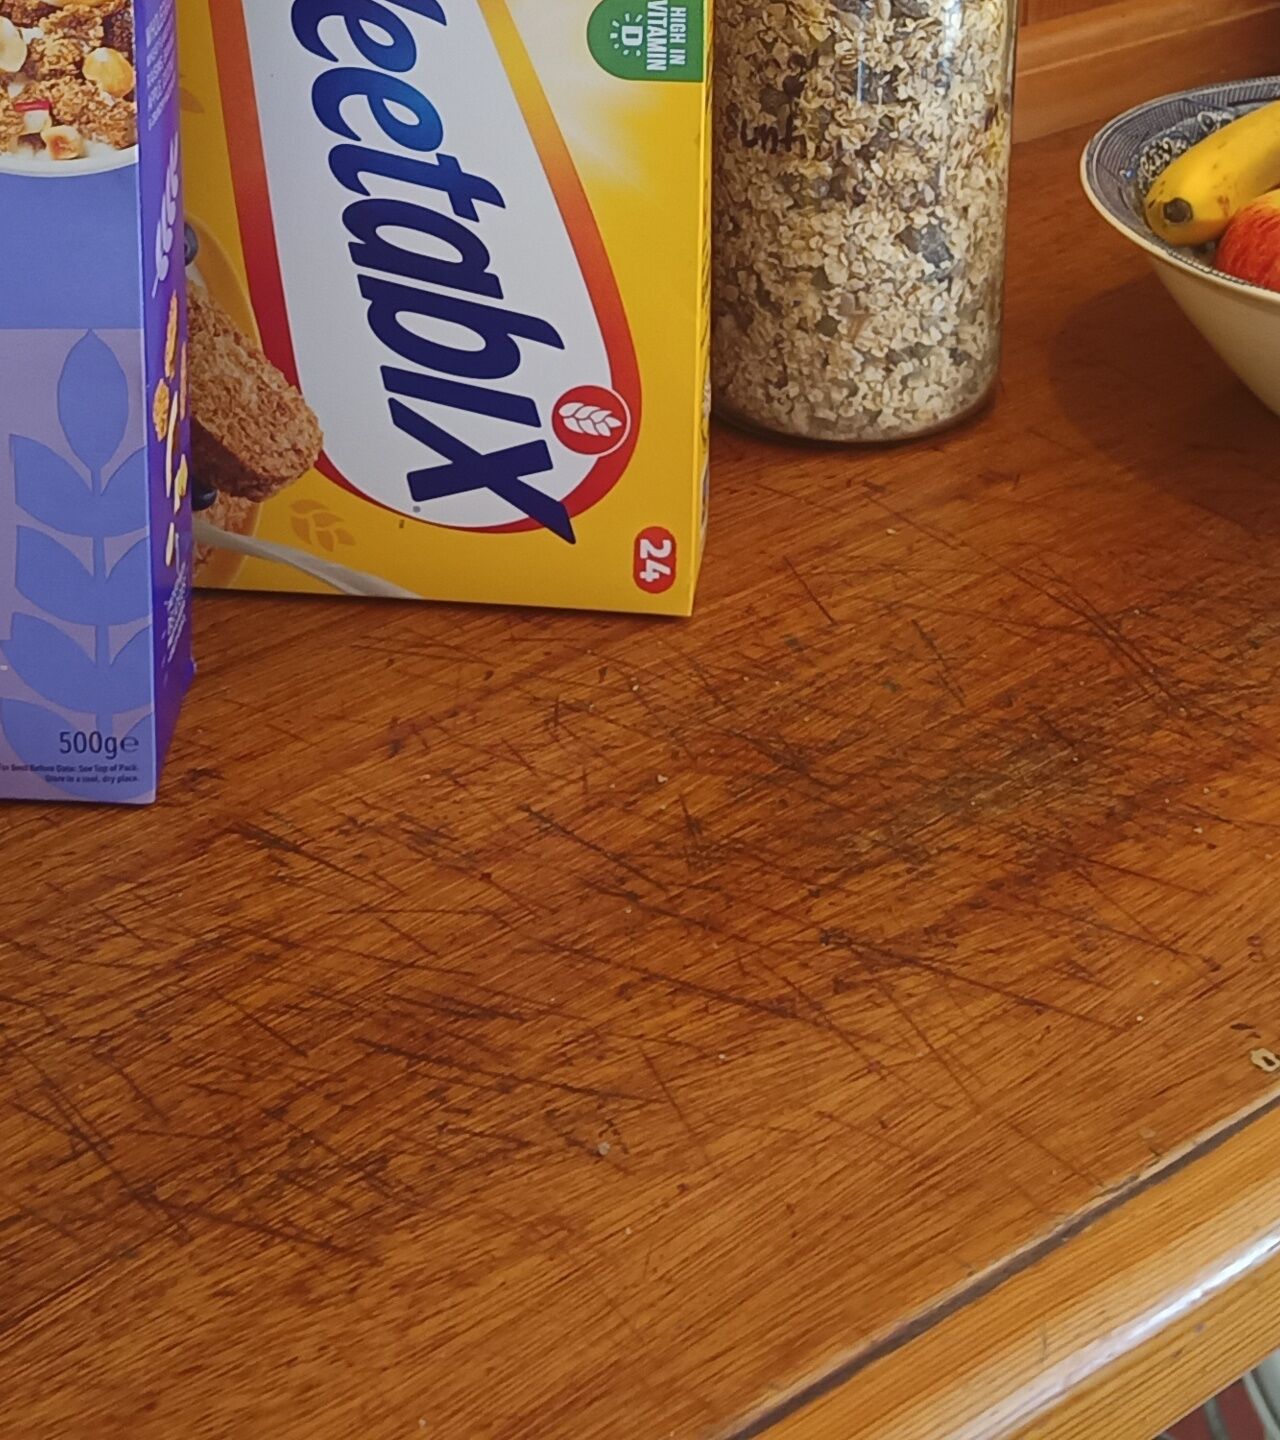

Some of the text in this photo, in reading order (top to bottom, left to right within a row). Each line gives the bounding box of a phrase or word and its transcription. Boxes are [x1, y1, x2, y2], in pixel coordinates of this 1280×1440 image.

[621, 25, 644, 47] D
[646, 0, 668, 71] VITAMIN
[669, 6, 687, 65] HIGH IN
[637, 537, 671, 581] 24
